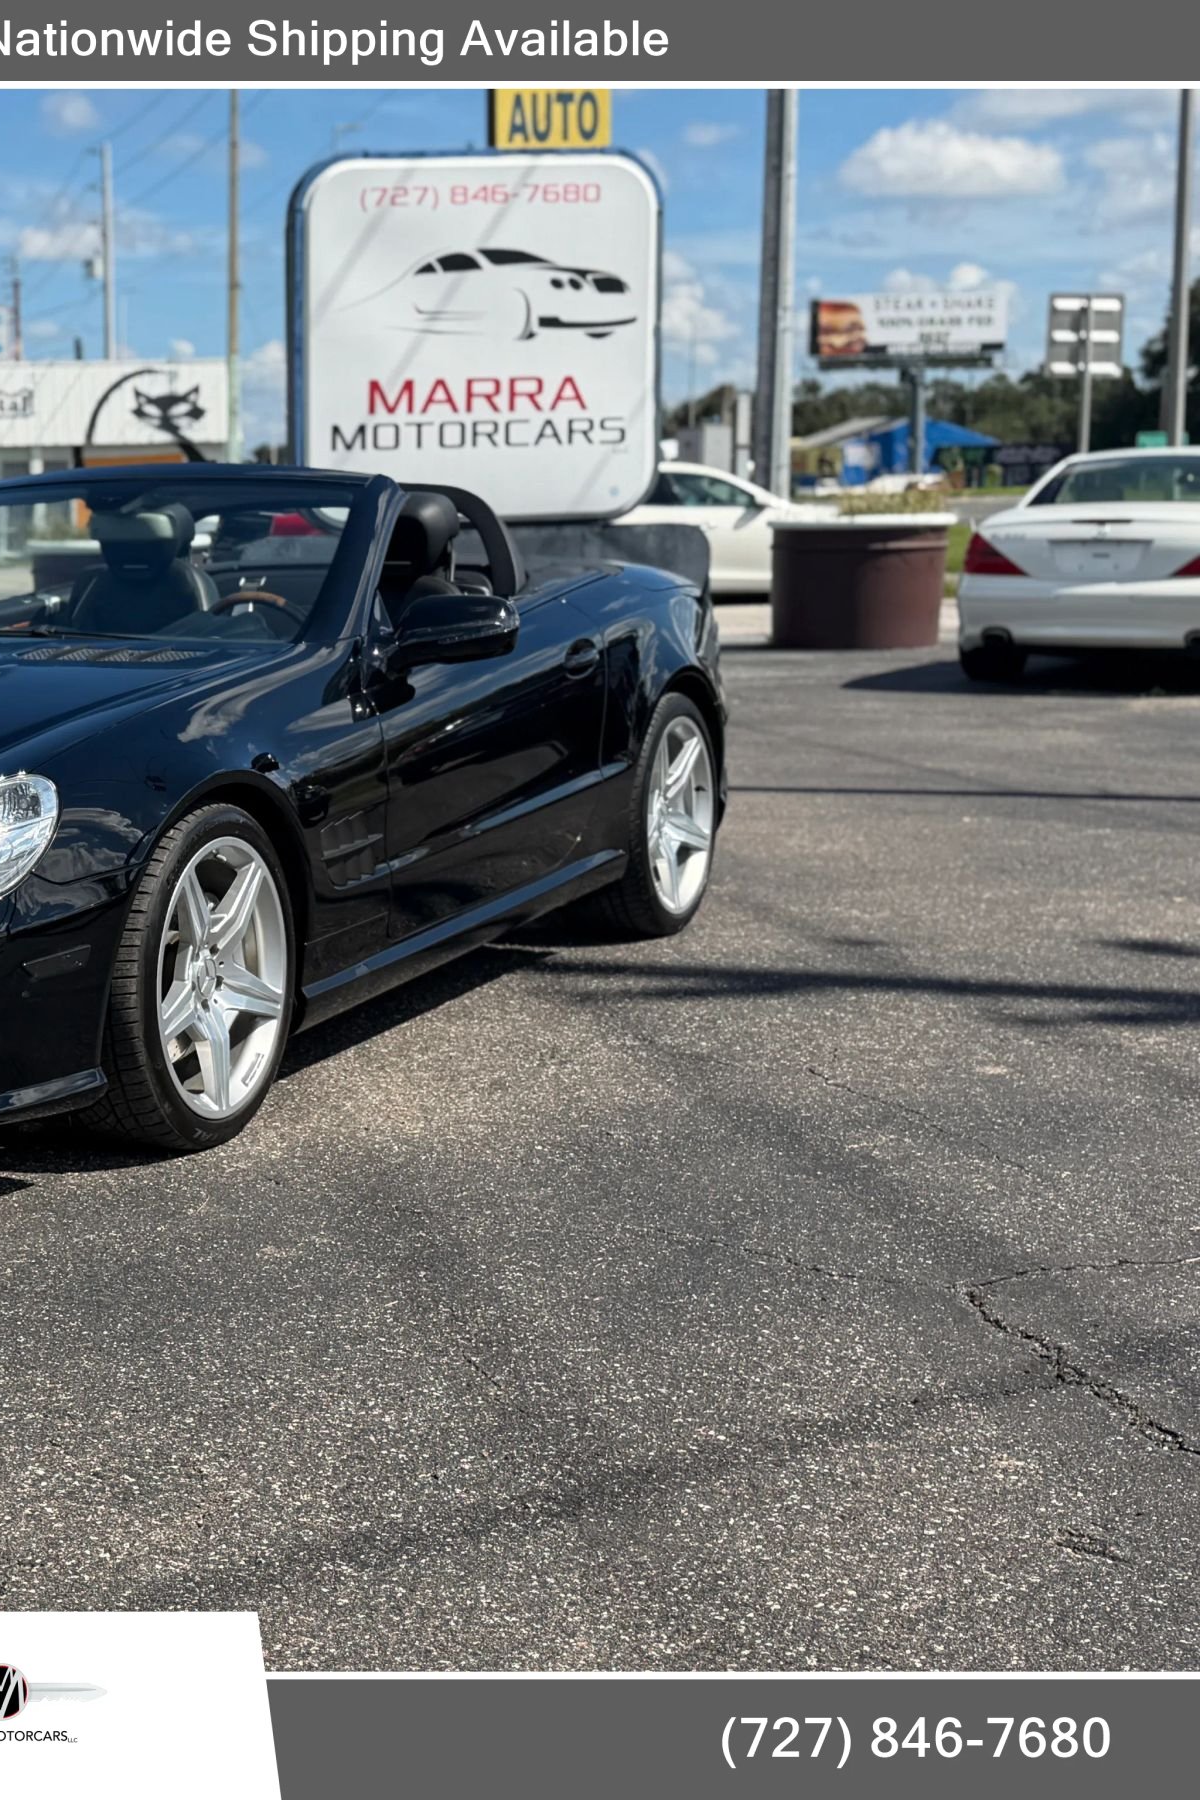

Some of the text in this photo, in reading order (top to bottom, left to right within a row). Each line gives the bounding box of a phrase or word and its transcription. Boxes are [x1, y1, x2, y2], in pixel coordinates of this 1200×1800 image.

[508, 91, 599, 142] AUTO
[359, 183, 602, 212] (727) 846-7680
[368, 376, 587, 415] MARRA
[331, 417, 626, 451] MOTORCARS
